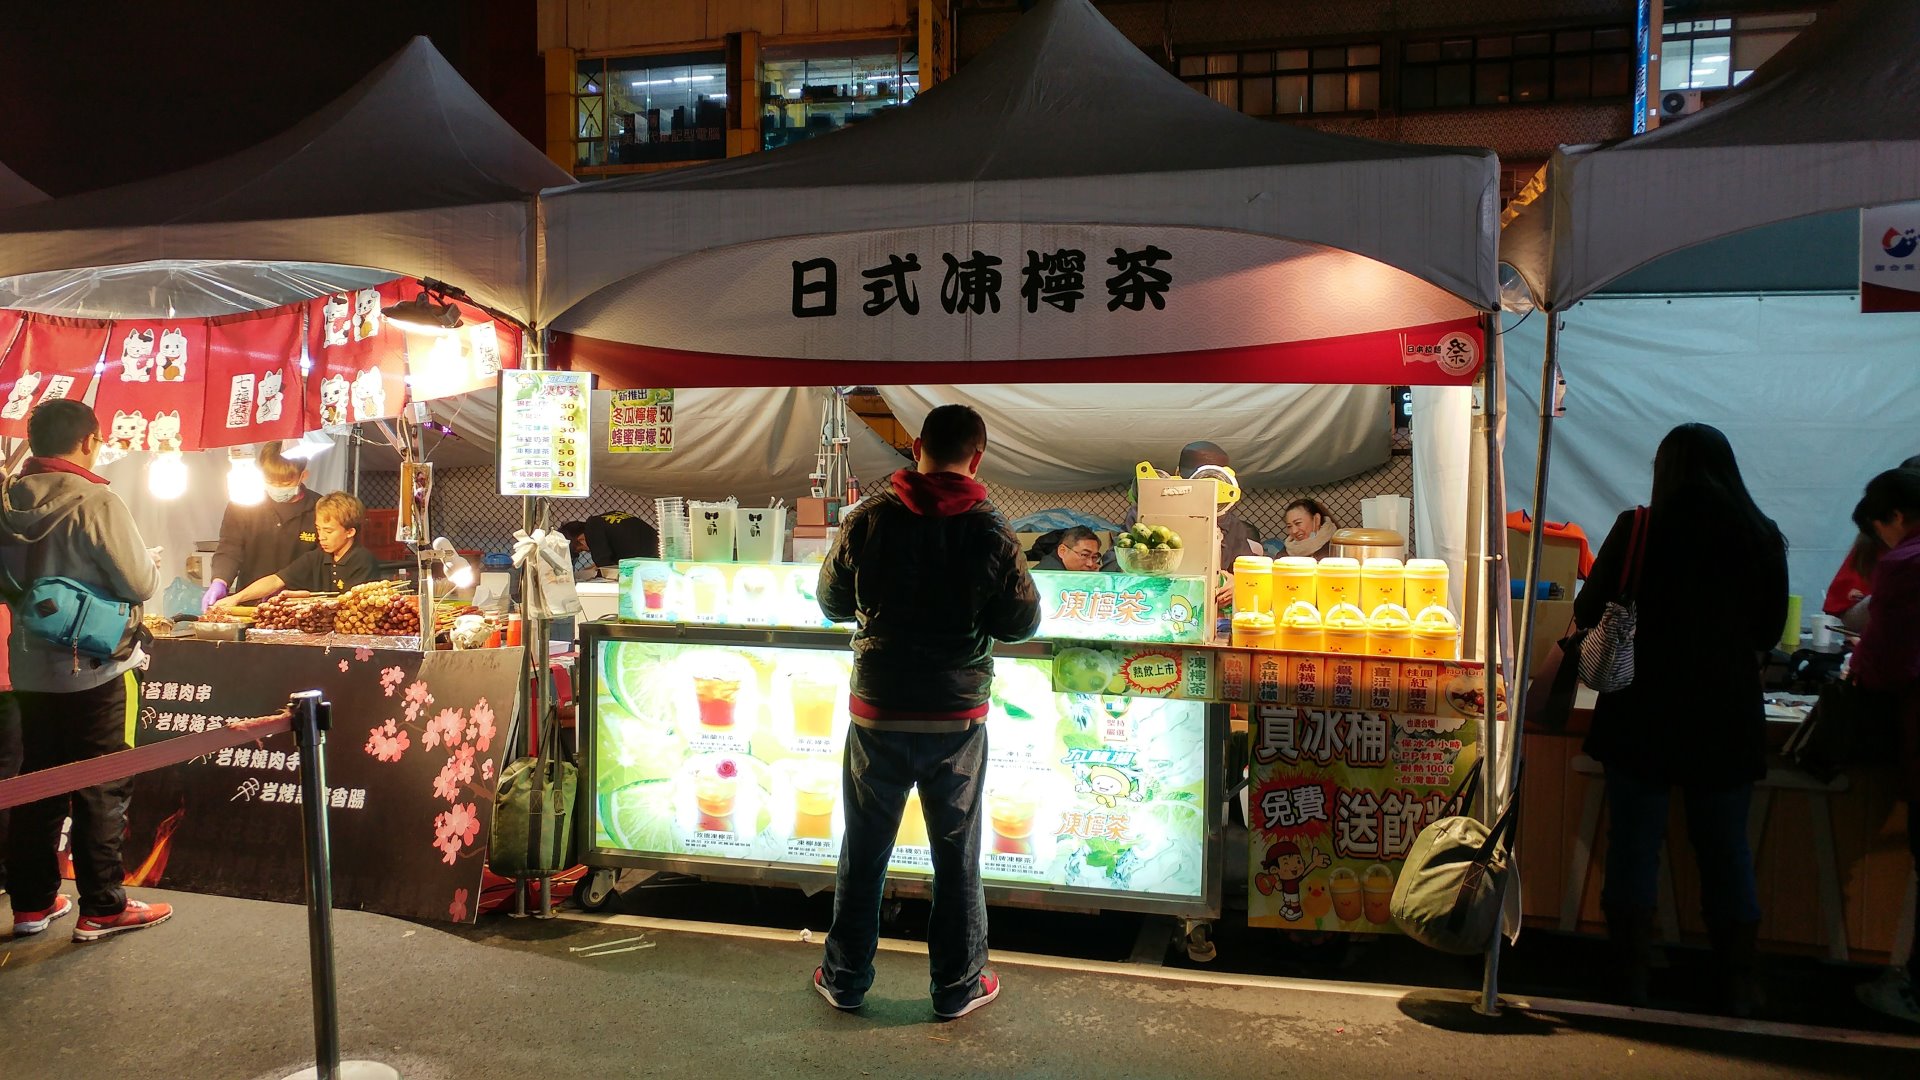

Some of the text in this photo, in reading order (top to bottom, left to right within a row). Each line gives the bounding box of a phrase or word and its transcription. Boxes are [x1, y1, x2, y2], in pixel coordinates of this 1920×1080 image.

[792, 245, 1173, 317] 日式凍檸茶
[1447, 338, 1471, 364] 祭
[618, 389, 648, 401] 新推出
[612, 405, 673, 425] 冬瓜檸檬 50
[612, 427, 672, 445] 蜂蜜檸檬 50
[1052, 589, 1154, 625] 凍檸茶
[1132, 663, 1175, 679] 熱飲上市
[1188, 656, 1207, 695] 凍檸茶
[140, 681, 213, 702] 苔雞肉串
[155, 711, 252, 733] 岩烤海苔
[1401, 740, 1462, 749] 保冰4小時
[1402, 751, 1443, 760] PP材質
[259, 782, 366, 809] 岩烤香腸
[1260, 785, 1328, 829] 免費
[1055, 811, 1131, 840] 凍檸茶
